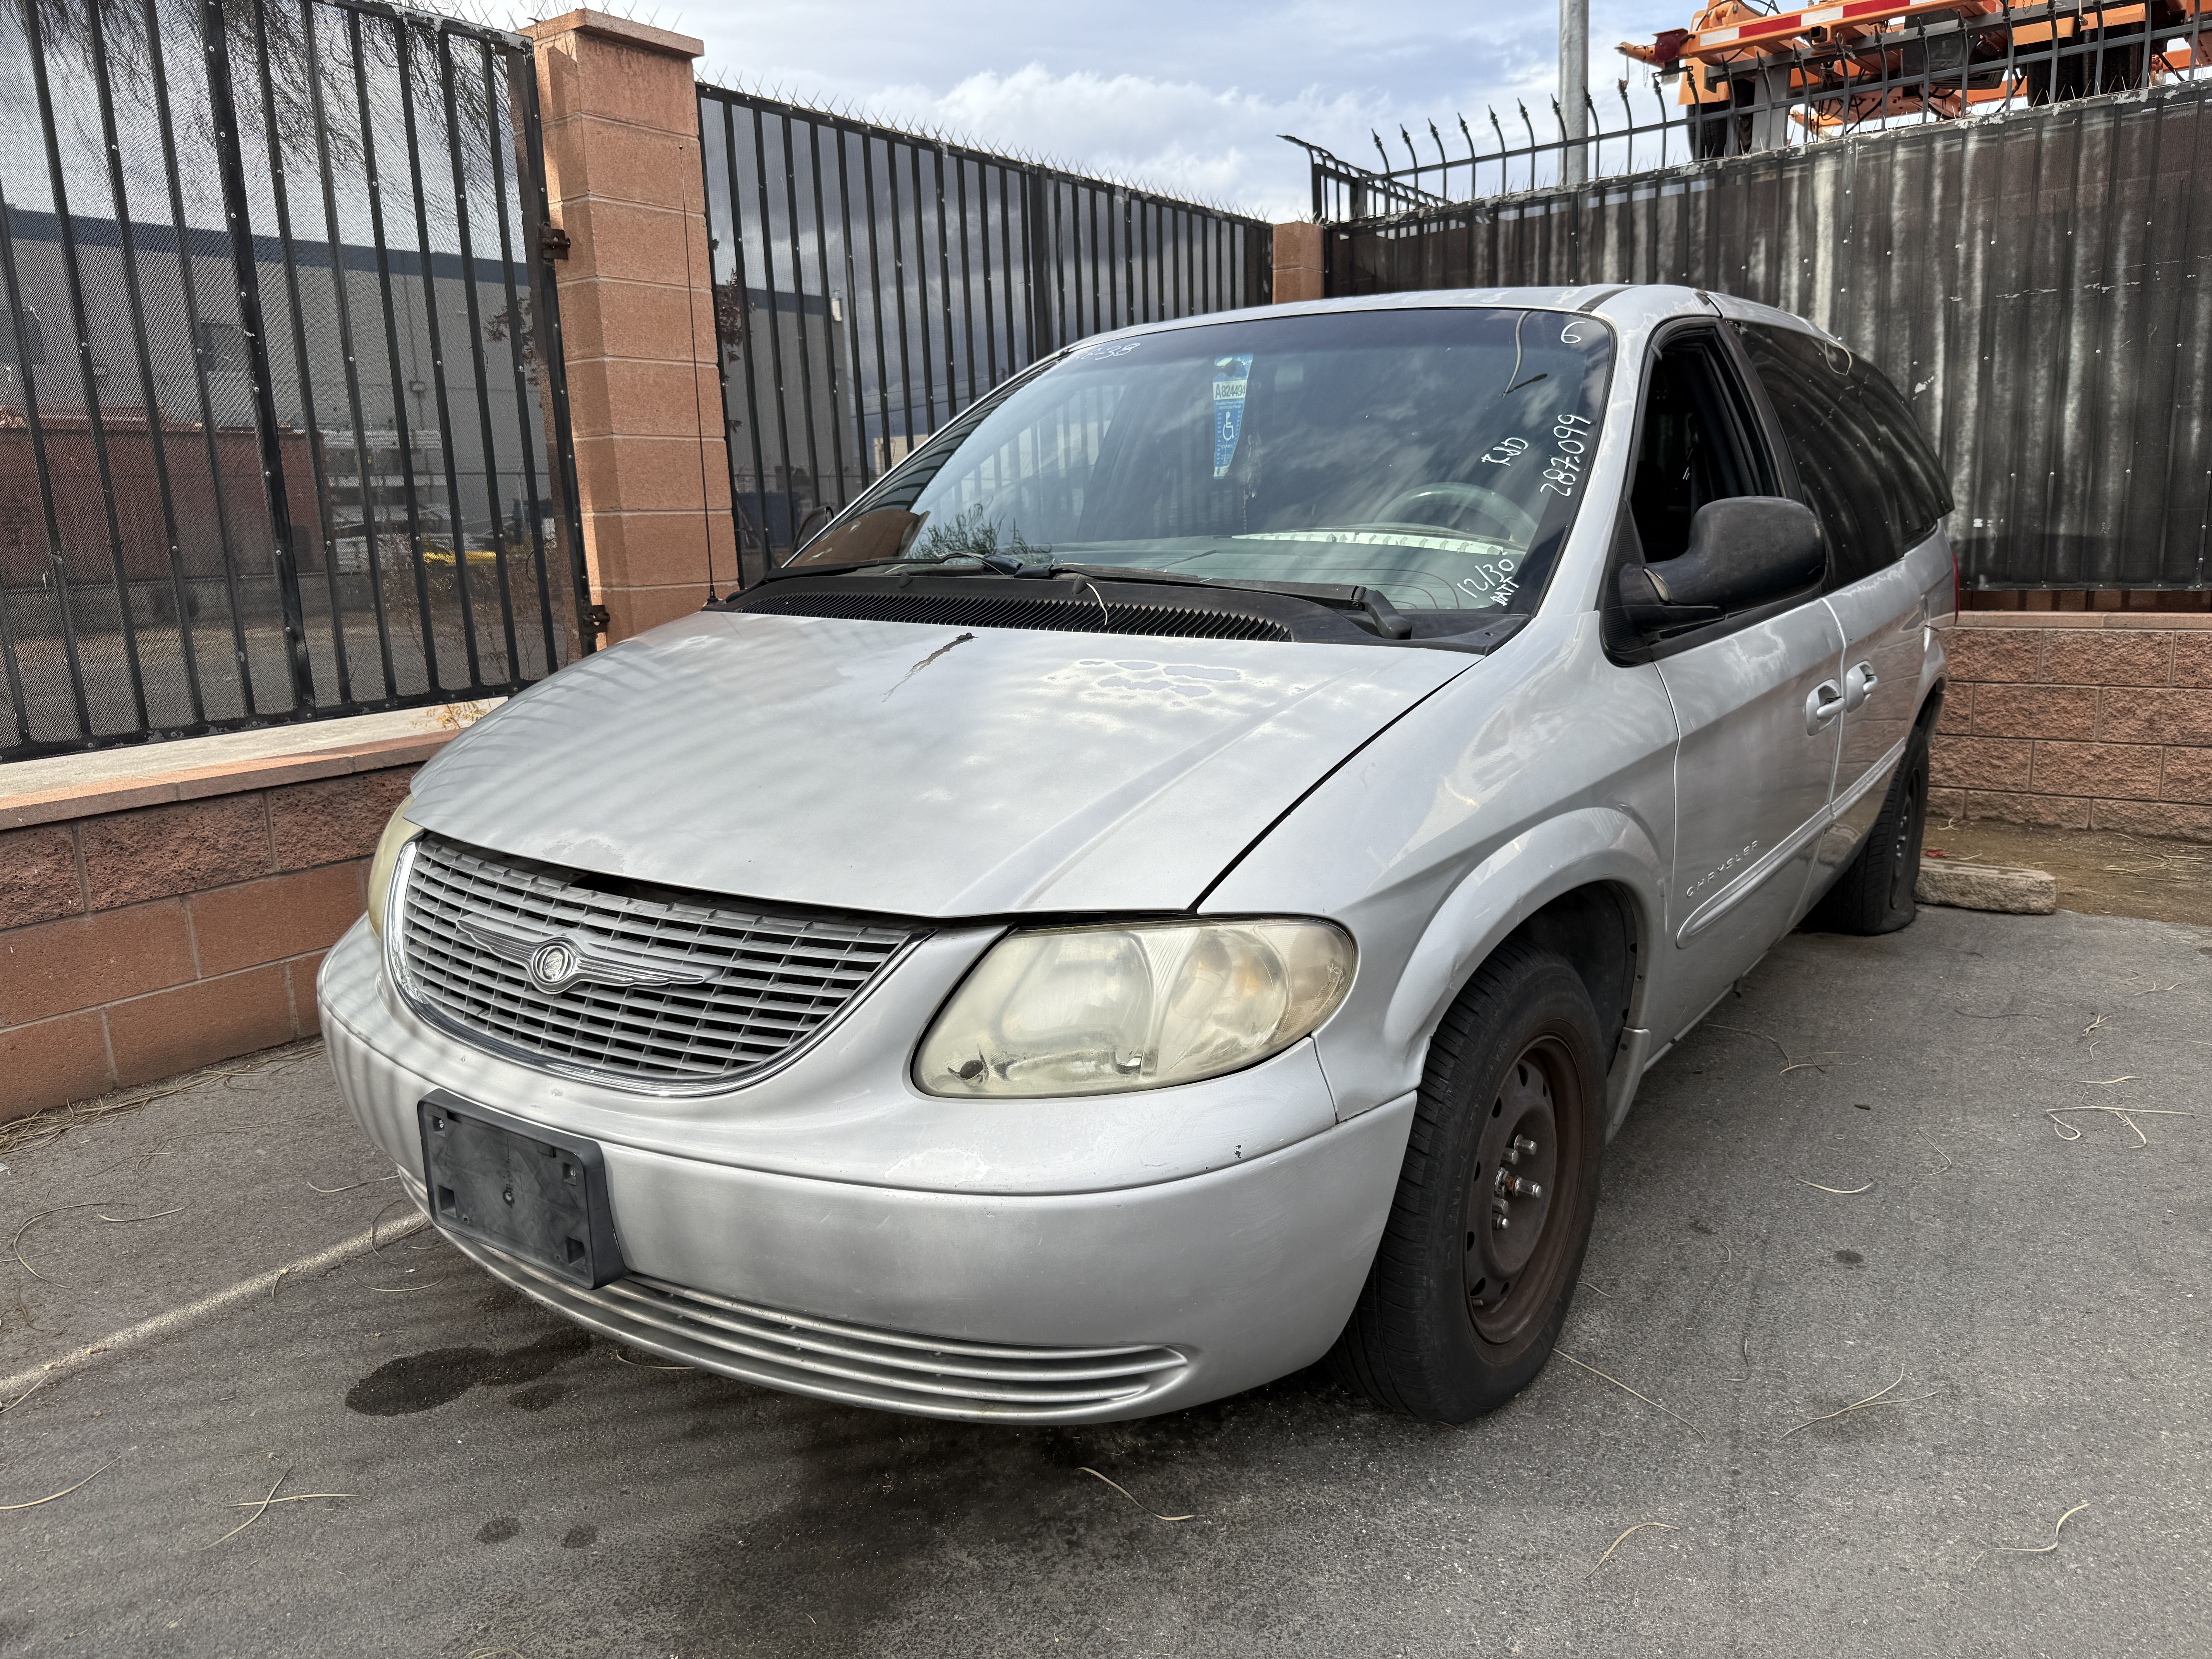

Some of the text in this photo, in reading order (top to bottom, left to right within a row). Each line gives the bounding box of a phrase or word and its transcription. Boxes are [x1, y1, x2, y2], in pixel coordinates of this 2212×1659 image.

[1561, 321, 1585, 343] 6
[1457, 559, 1514, 598] 12/30
[1686, 840, 1759, 897] CHRYSLER
